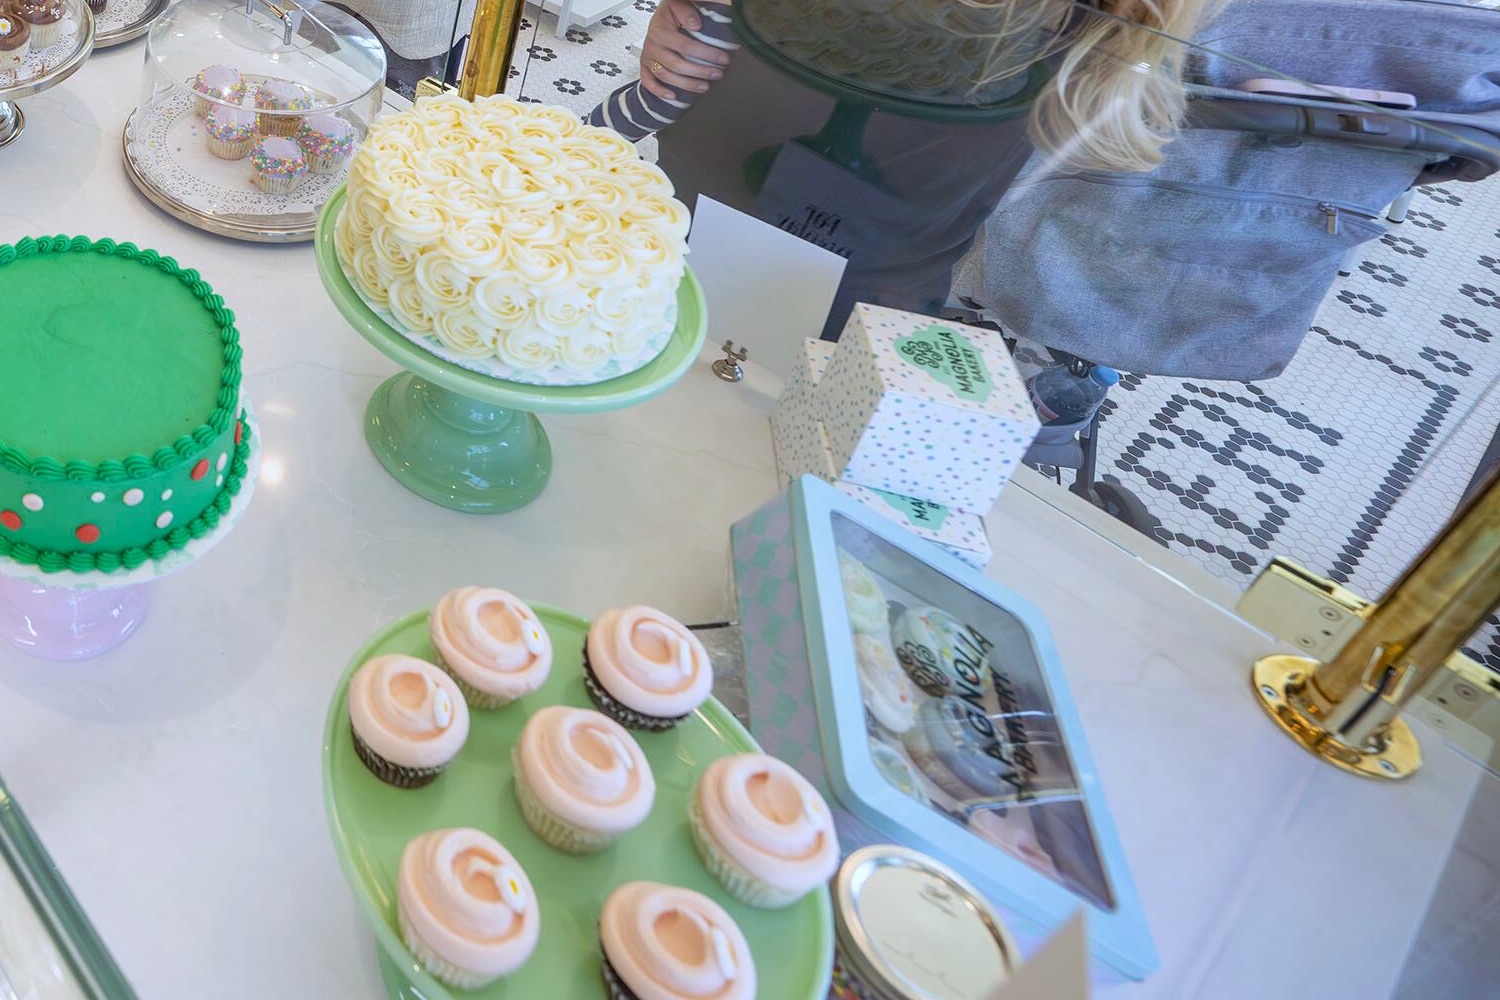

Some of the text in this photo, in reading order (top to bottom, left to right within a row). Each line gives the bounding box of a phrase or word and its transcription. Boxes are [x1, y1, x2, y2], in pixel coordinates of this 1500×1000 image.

[938, 332, 975, 394] MAGNOLIA
[961, 347, 986, 384] BAKERY
[954, 624, 1037, 802] MAGNOLIA
